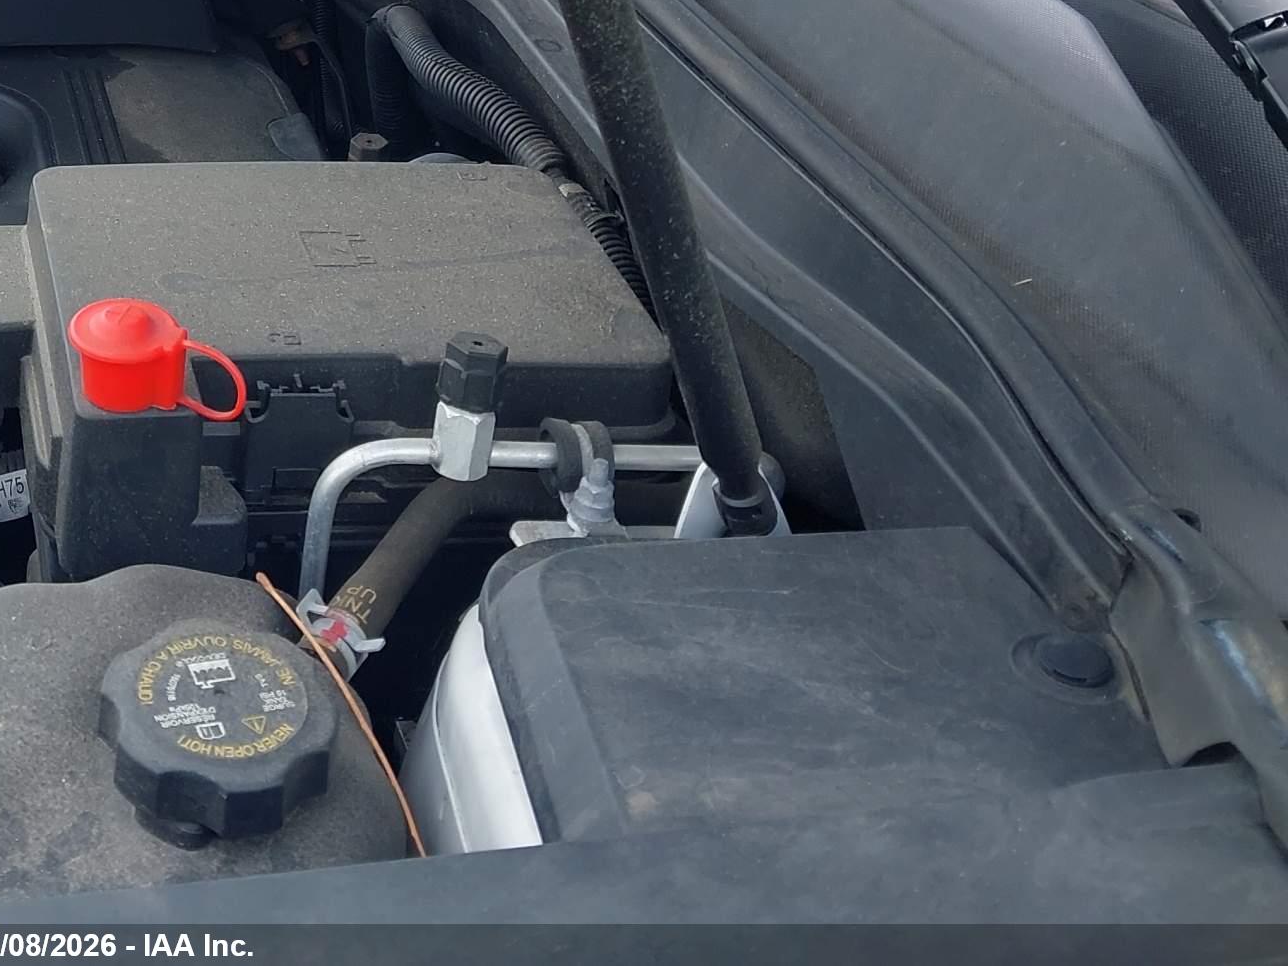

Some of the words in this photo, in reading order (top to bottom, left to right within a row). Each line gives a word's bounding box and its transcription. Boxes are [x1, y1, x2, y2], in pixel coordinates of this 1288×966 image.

[346, 585, 377, 604] UP
[167, 636, 227, 655] OUVRIR
[233, 639, 281, 666] JAMAIS
[177, 735, 212, 754] HOT!
[253, 723, 295, 752] NEVER
[214, 745, 255, 758] OPEN
